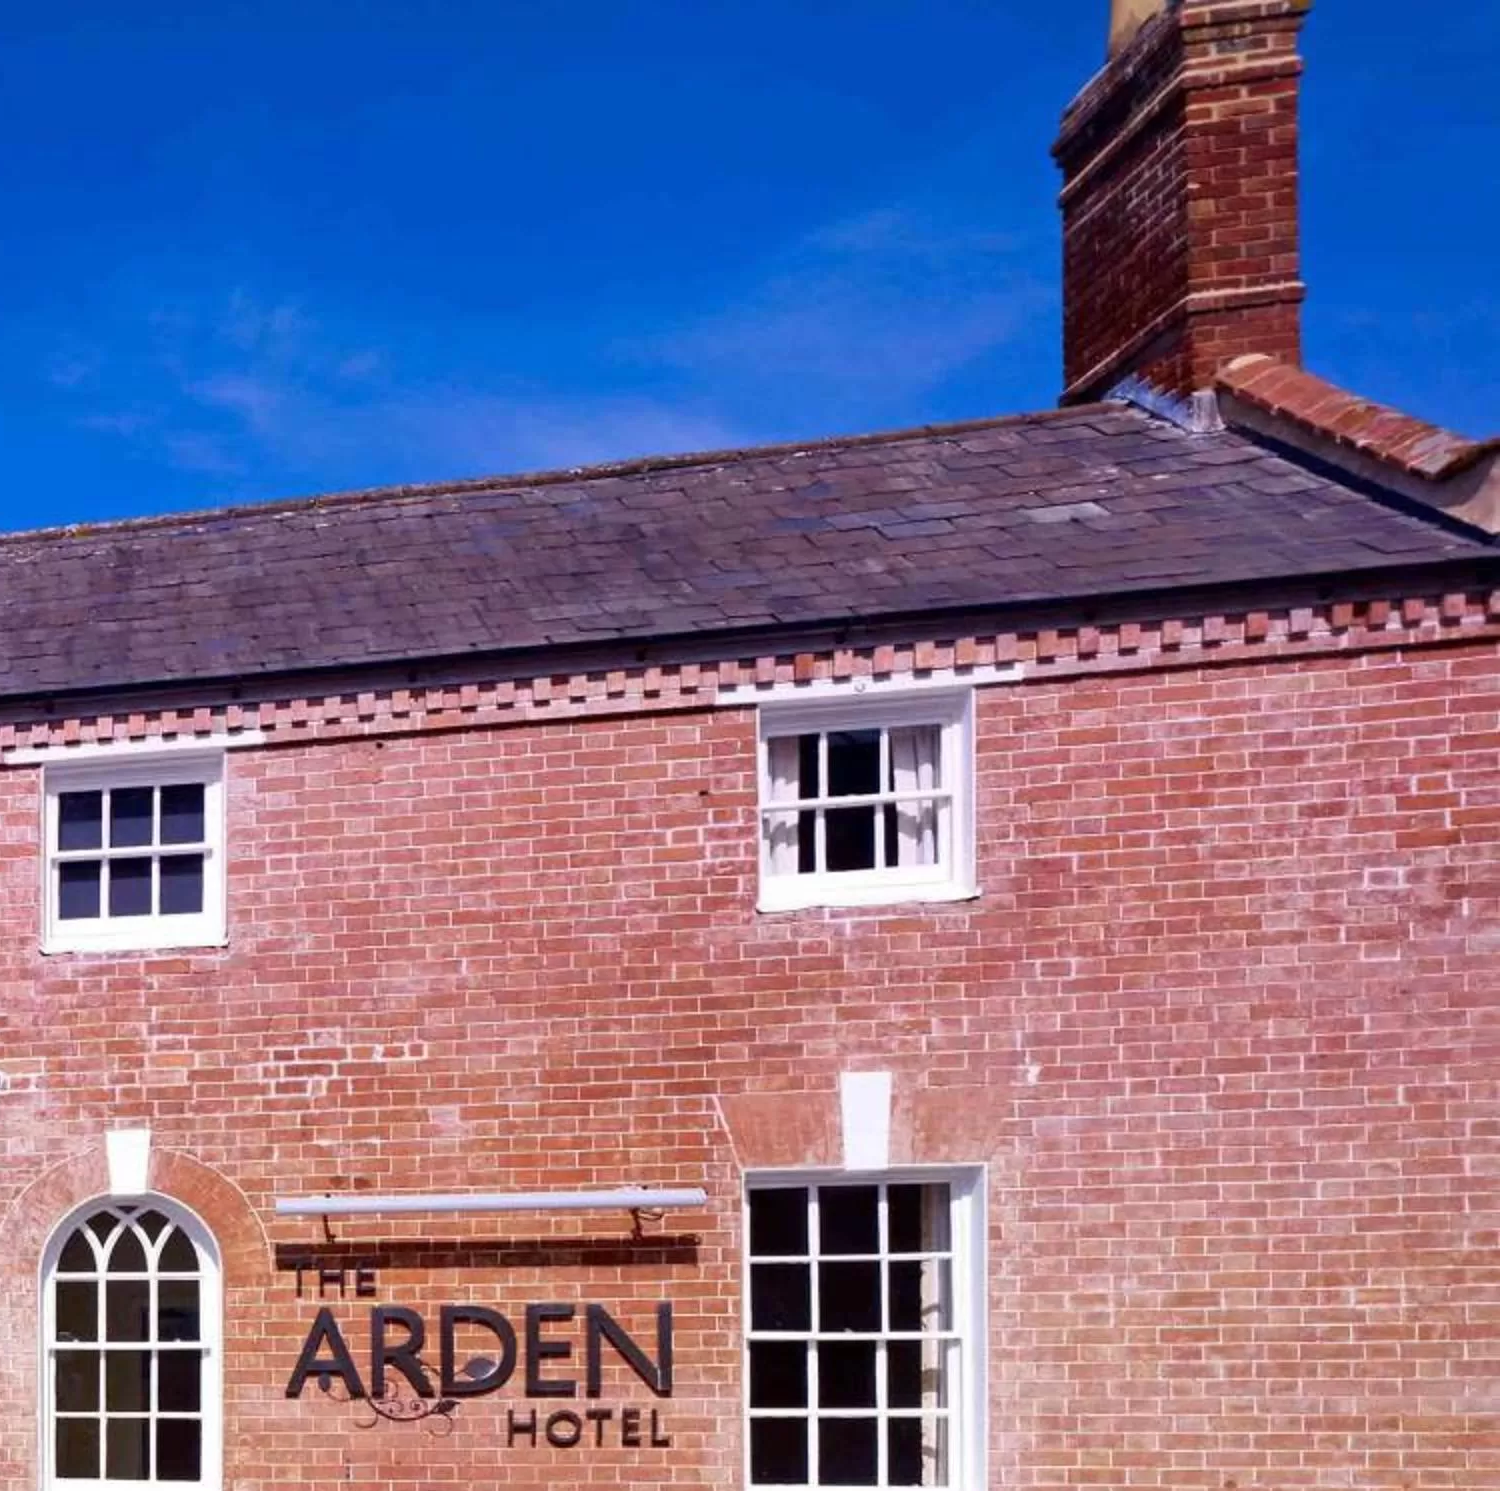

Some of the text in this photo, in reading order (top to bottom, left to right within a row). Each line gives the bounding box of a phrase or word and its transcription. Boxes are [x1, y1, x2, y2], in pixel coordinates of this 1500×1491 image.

[289, 1256, 377, 1297] THE
[285, 1302, 673, 1399] ARDEN
[506, 1407, 671, 1449] HOTEL
